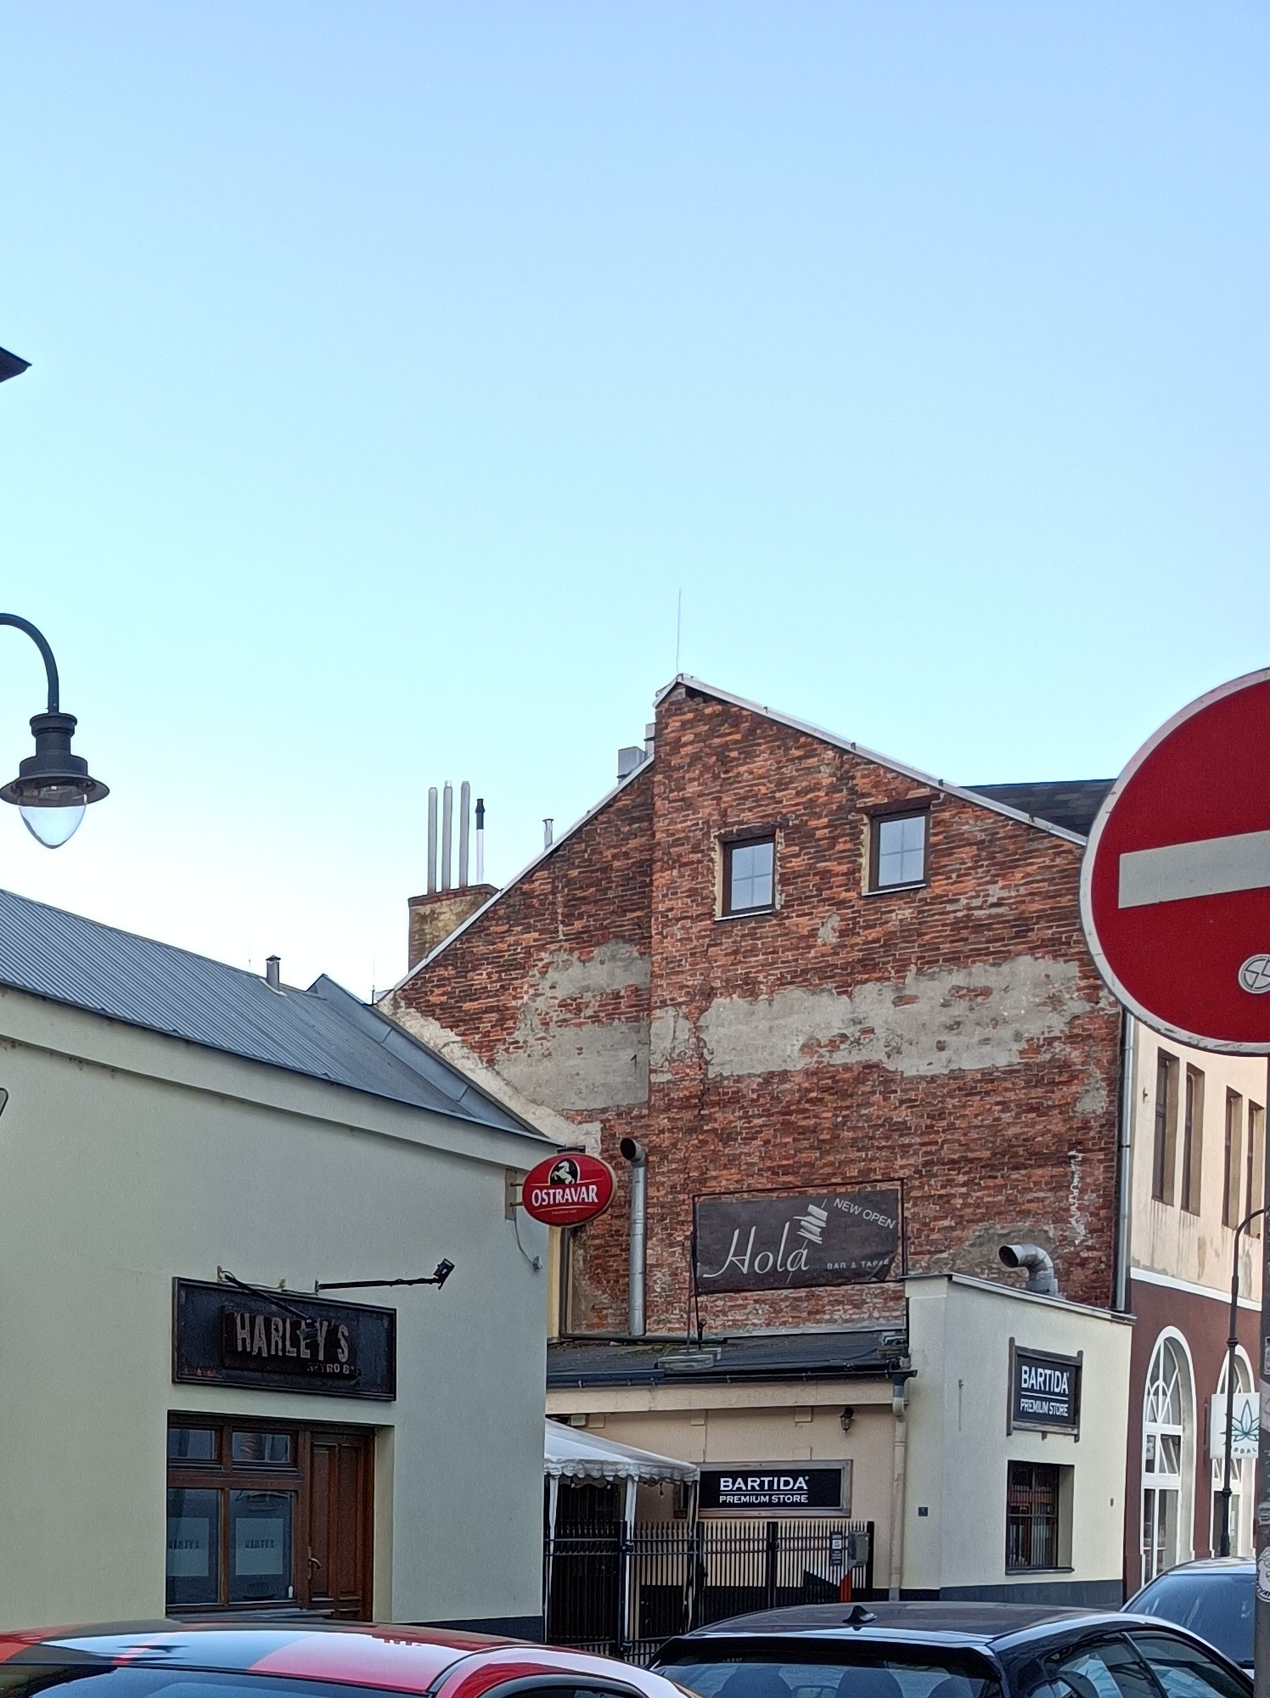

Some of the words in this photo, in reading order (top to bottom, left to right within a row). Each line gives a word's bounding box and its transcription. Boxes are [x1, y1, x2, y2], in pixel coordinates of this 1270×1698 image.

[531, 1184, 599, 1207] OSTRAVAR
[833, 1198, 863, 1216] NEW
[862, 1208, 897, 1230] OPEN
[826, 1262, 847, 1270] BAR
[236, 1312, 349, 1363] HARLEY'S
[1021, 1365, 1069, 1395] BARTIDA
[1020, 1398, 1049, 1415] PREMIUM
[1049, 1402, 1069, 1417] STORE
[720, 1476, 809, 1491] BARTIDA
[719, 1495, 769, 1504] PREMIUM
[771, 1494, 809, 1503] STORE
